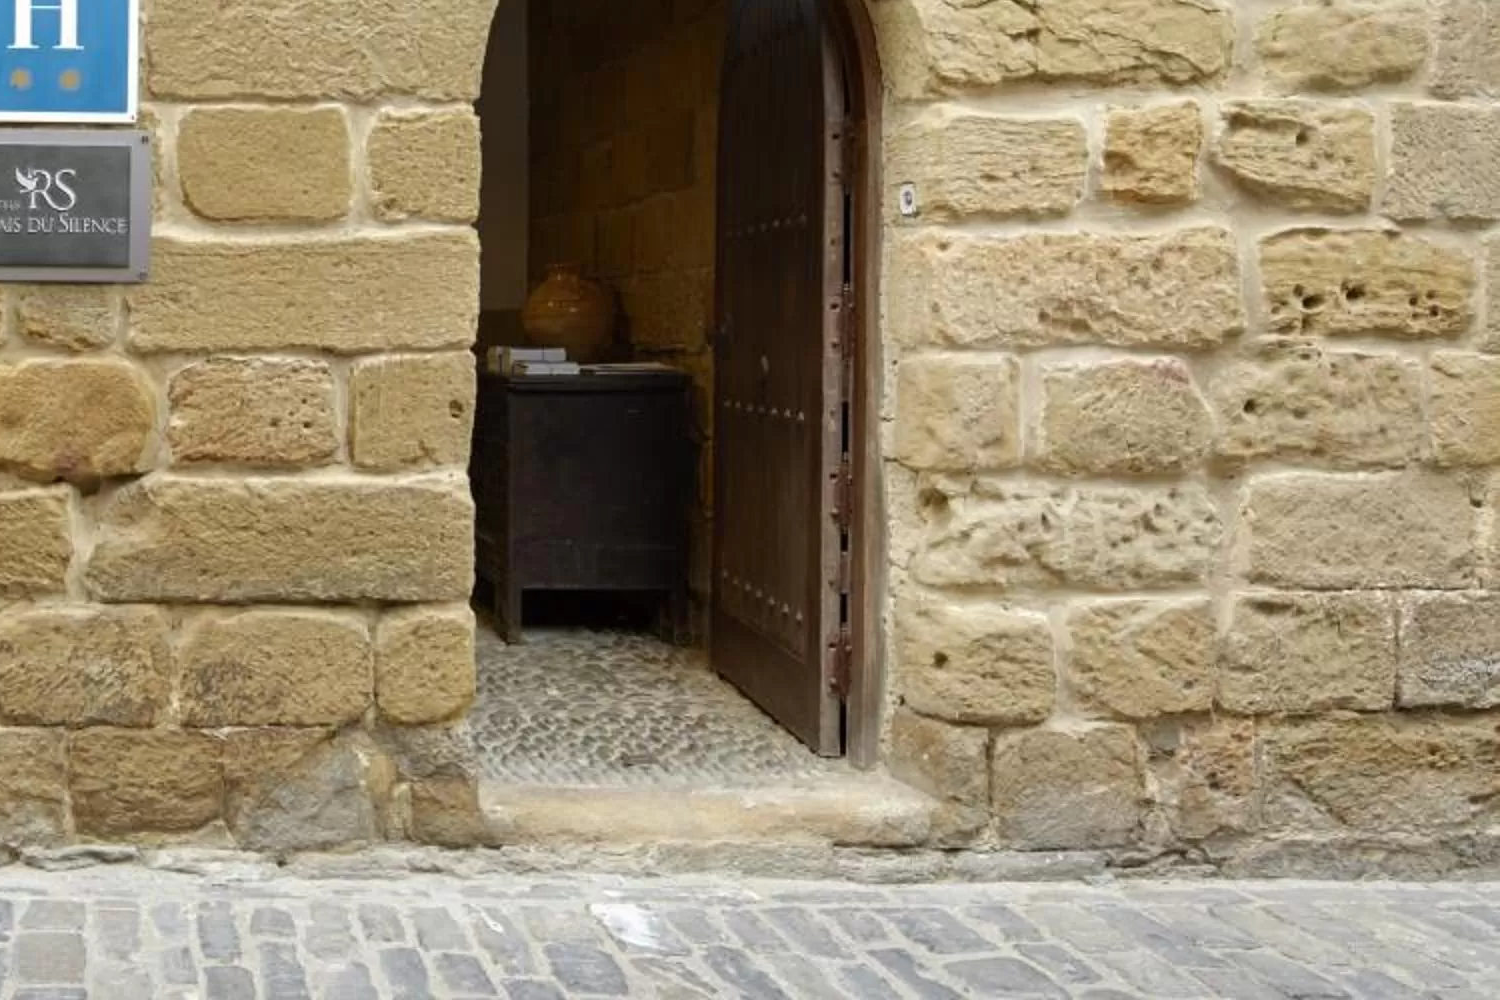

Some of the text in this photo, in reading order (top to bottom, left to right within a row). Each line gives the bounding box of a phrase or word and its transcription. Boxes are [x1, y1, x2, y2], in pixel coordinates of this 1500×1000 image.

[21, 168, 76, 211] RS
[27, 216, 54, 233] DU
[58, 212, 128, 234] SILENCE
